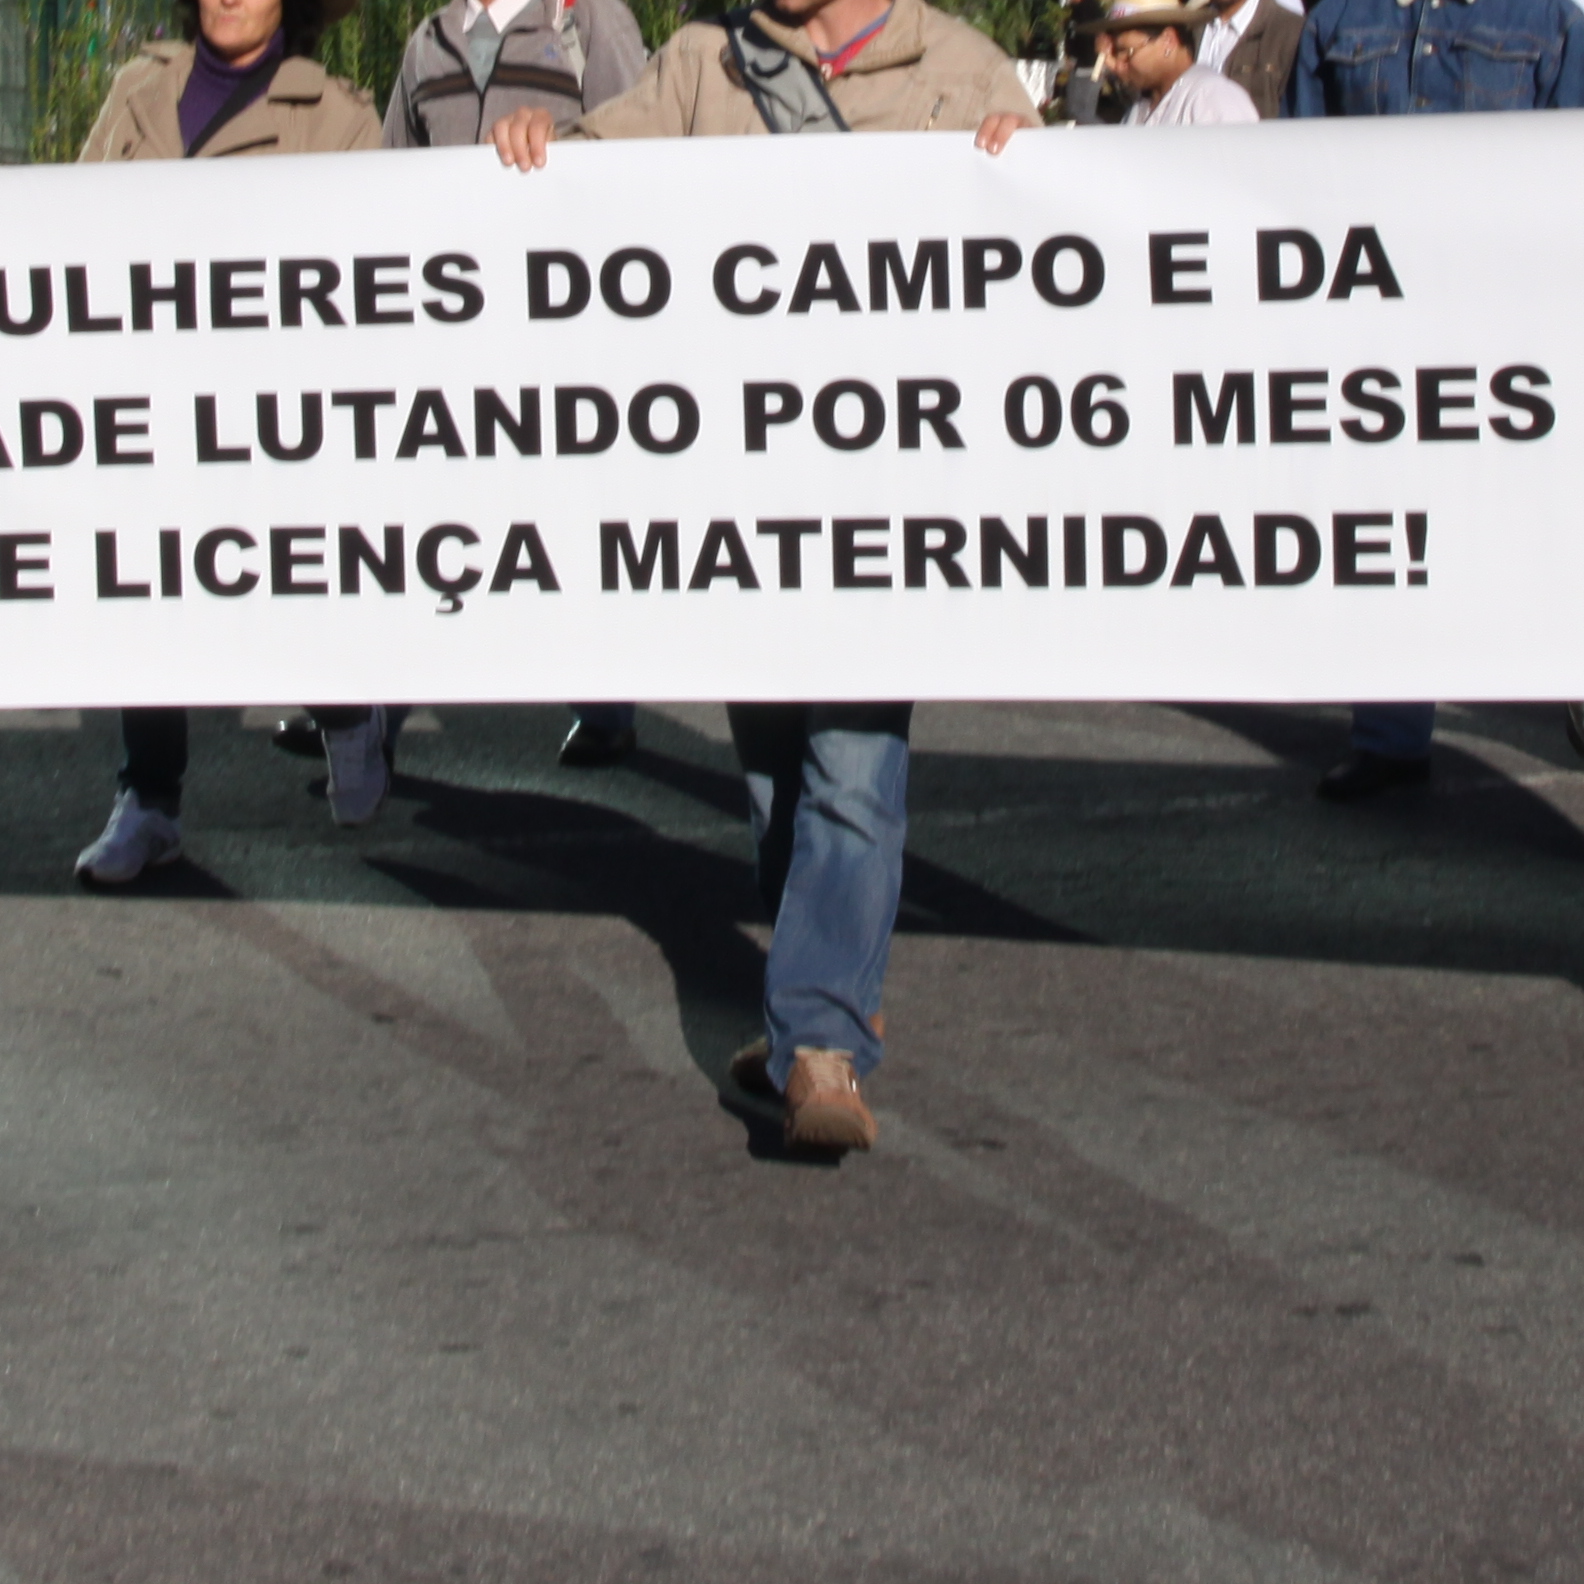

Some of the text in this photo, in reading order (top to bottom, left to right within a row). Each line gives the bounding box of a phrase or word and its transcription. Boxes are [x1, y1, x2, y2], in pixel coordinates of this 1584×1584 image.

[527, 248, 670, 319] DO
[714, 235, 1105, 315] CAMPO
[1150, 232, 1212, 304] E
[1258, 226, 1403, 301] DA
[196, 384, 700, 463] LUTANDO
[743, 379, 964, 451] POR
[1004, 374, 1130, 448] 06
[1173, 365, 1555, 445] MESES
[96, 524, 560, 613] LICENÇA
[600, 513, 1428, 591] MATERNIDADE!
